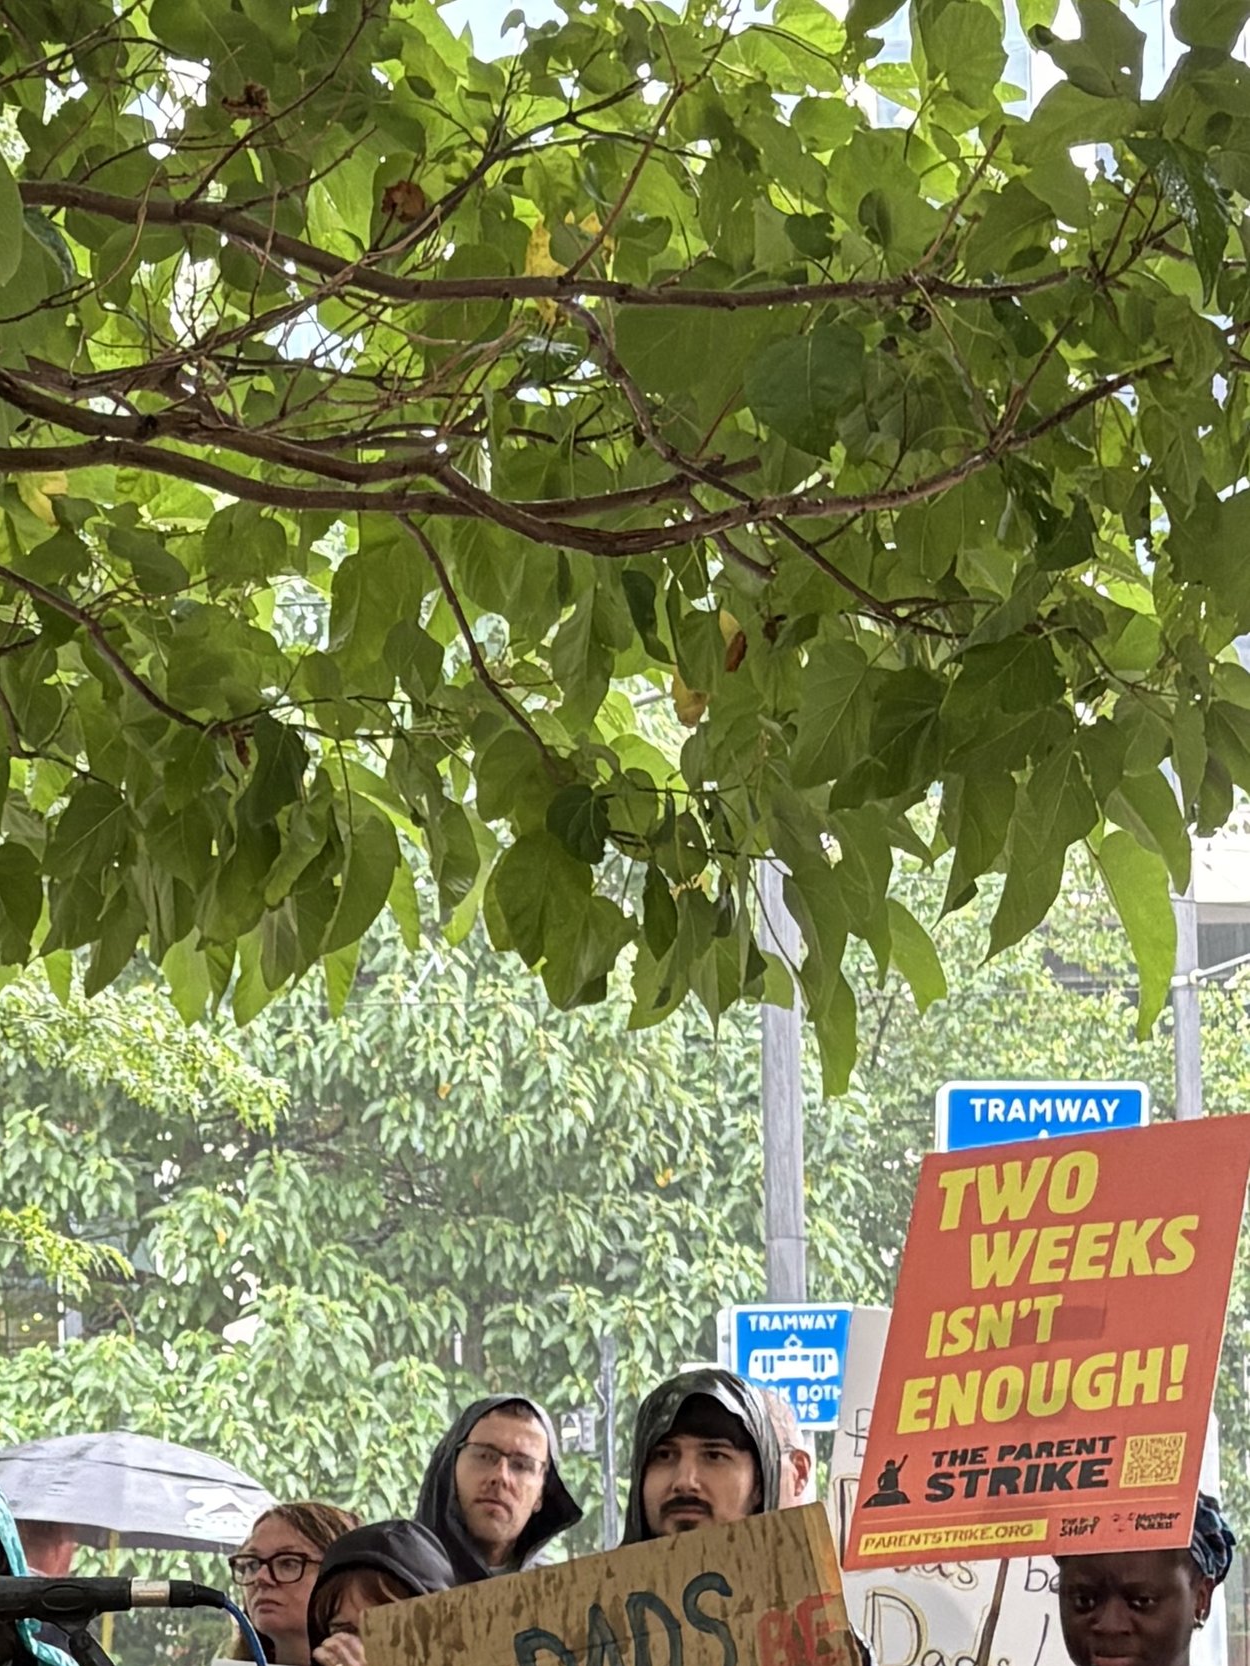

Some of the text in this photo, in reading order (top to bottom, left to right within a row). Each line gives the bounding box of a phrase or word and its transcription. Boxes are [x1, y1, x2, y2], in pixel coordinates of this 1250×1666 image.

[969, 1097, 1120, 1123] TRAMWAY
[937, 1150, 1099, 1231] TWO
[969, 1214, 1199, 1290] WEEKS
[748, 1313, 838, 1332] TRAMWAY
[924, 1294, 1063, 1359] ISN'T
[896, 1344, 1190, 1435] ENOUGH!
[931, 1435, 1118, 1469] THE PARENT
[924, 1457, 1113, 1503] STRIKE
[863, 1525, 1034, 1551] PARENTSTRIKE.ORG
